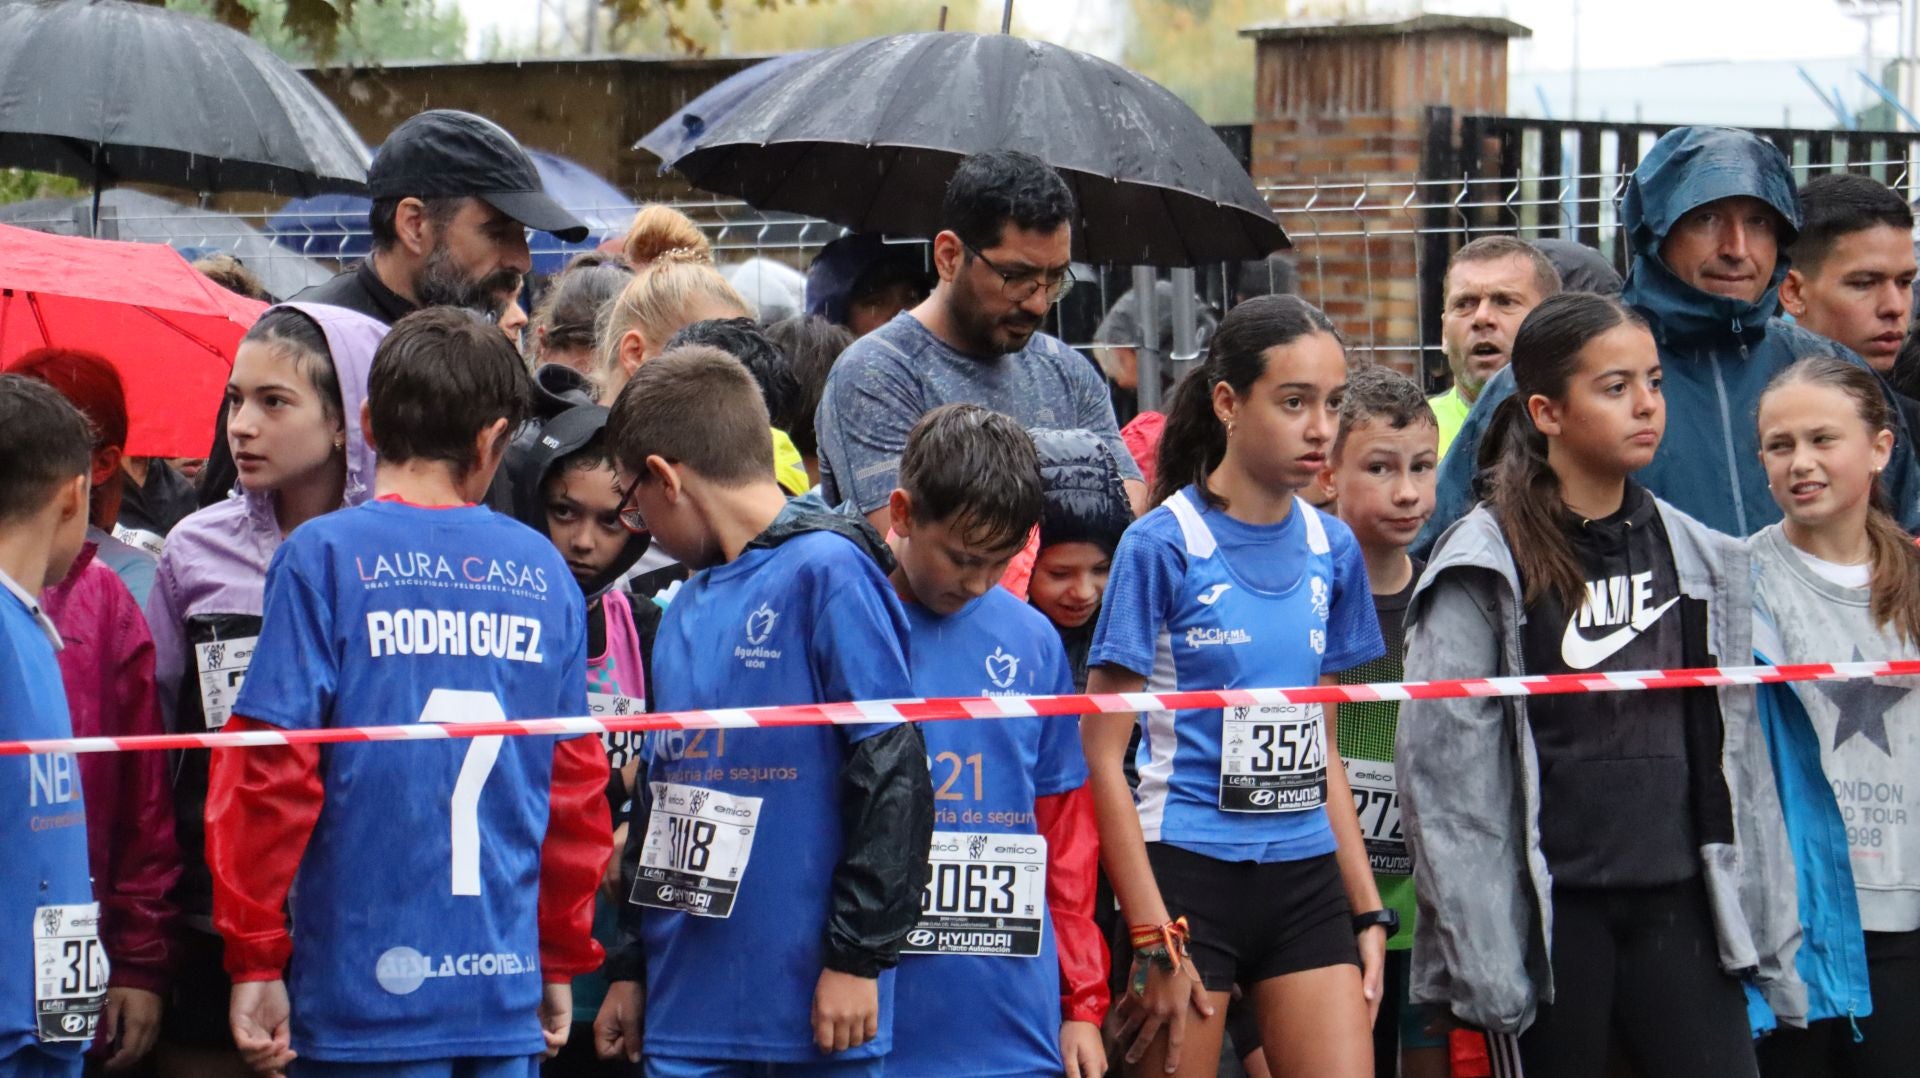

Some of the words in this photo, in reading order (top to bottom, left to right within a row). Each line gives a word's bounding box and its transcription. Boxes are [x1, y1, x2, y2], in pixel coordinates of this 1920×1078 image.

[356, 552, 455, 581] LAURA
[462, 556, 549, 594] CASAS
[366, 608, 544, 664] RODRIGUEZ
[1251, 720, 1321, 773] 3523
[705, 766, 724, 781] de
[729, 765, 798, 783] seguros
[1354, 770, 1393, 782] emico
[418, 688, 507, 896] 7
[1831, 779, 1904, 805] ONDON
[713, 804, 752, 818] emico
[961, 807, 983, 824] de
[1860, 807, 1908, 825] TOUR
[668, 816, 717, 873] 3118
[929, 841, 960, 852] mico
[1846, 826, 1883, 849] 998
[994, 843, 1038, 855] emico
[938, 932, 1012, 947] HYUNDAI
